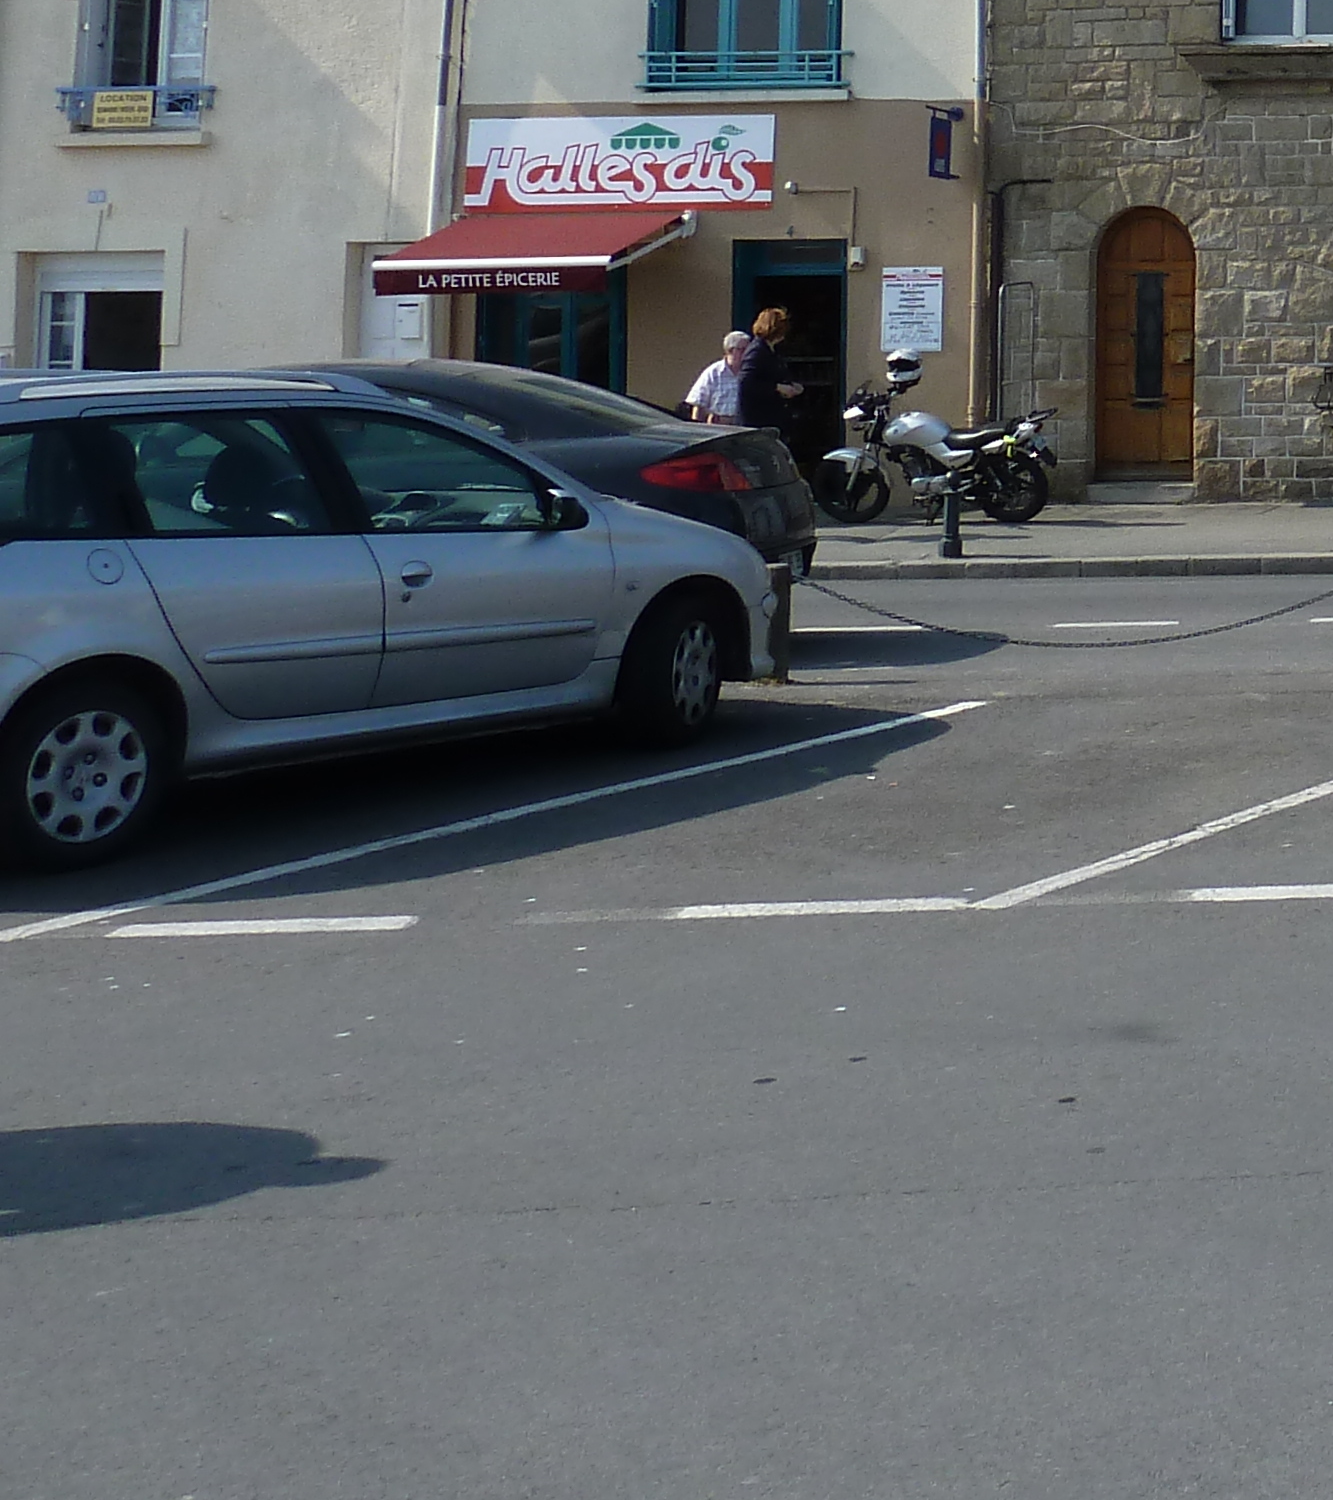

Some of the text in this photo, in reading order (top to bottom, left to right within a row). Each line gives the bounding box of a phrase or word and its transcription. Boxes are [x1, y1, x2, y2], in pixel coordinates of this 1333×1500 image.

[100, 94, 147, 103] LOCATION
[418, 270, 560, 288] LA PETITE ÉPICERIE
